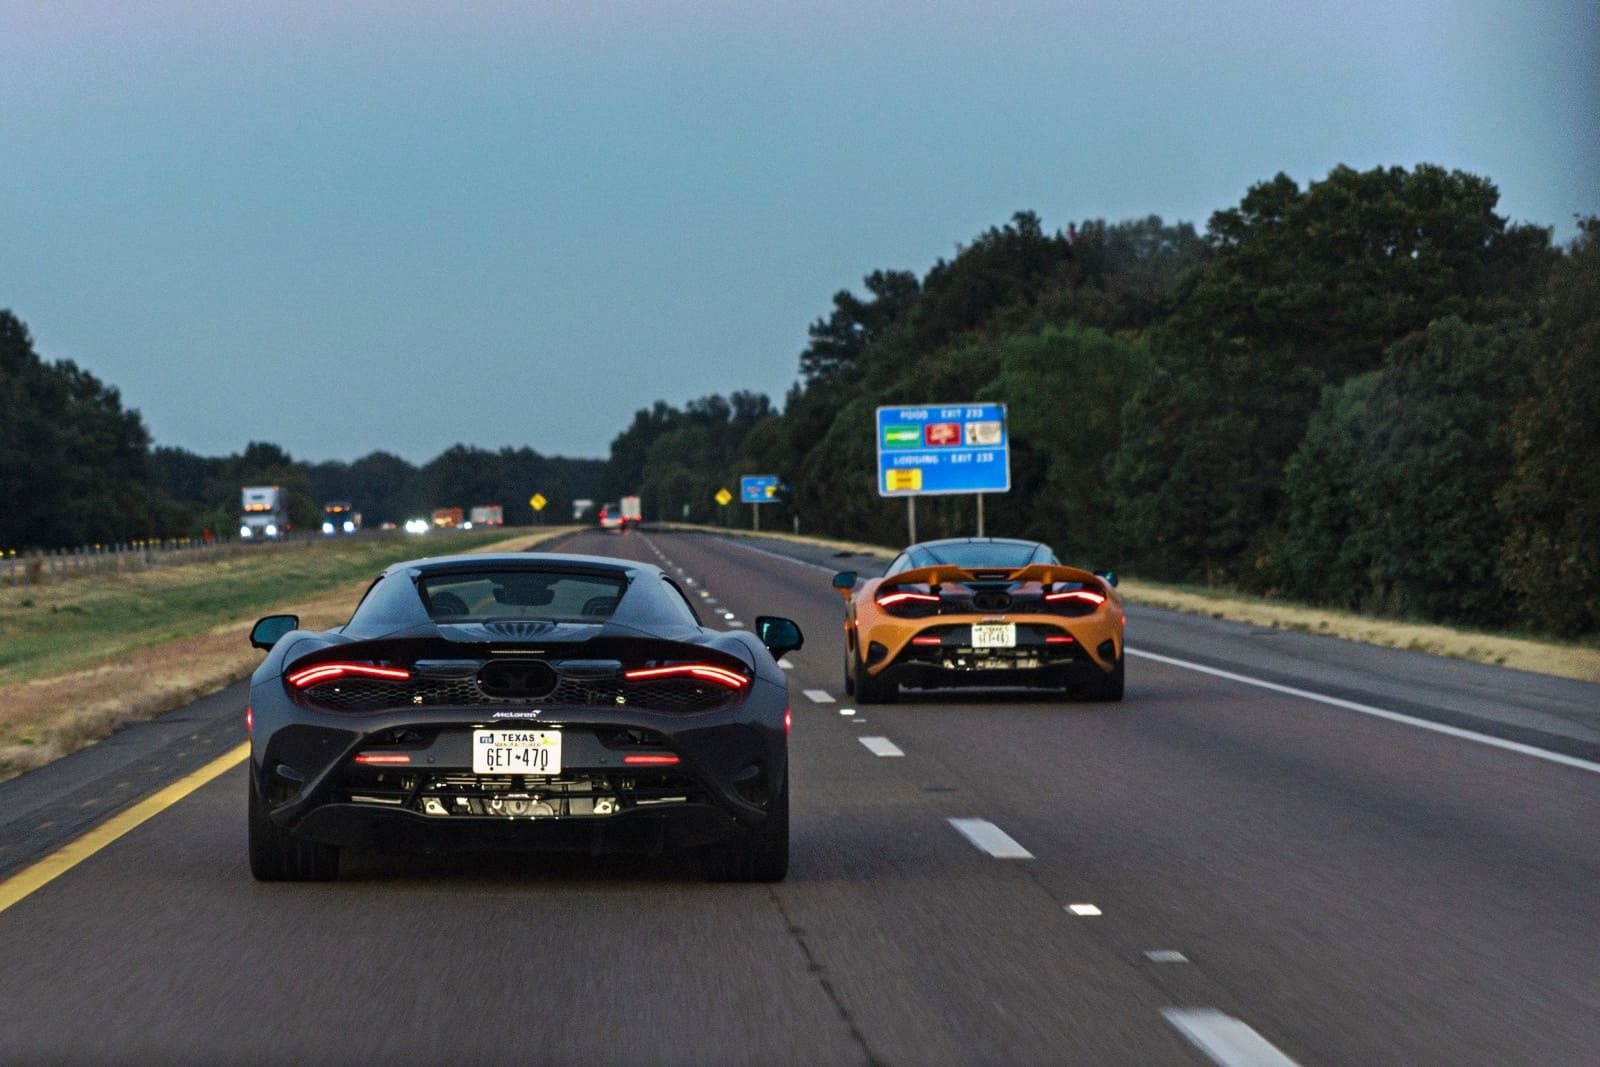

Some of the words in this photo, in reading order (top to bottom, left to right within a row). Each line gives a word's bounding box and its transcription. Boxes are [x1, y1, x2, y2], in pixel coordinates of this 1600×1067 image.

[900, 410, 928, 420] FOOD
[941, 409, 961, 418] EXIT
[894, 455, 939, 465] LODGING
[951, 454, 972, 464] EXIT
[501, 733, 535, 742] TEXAS
